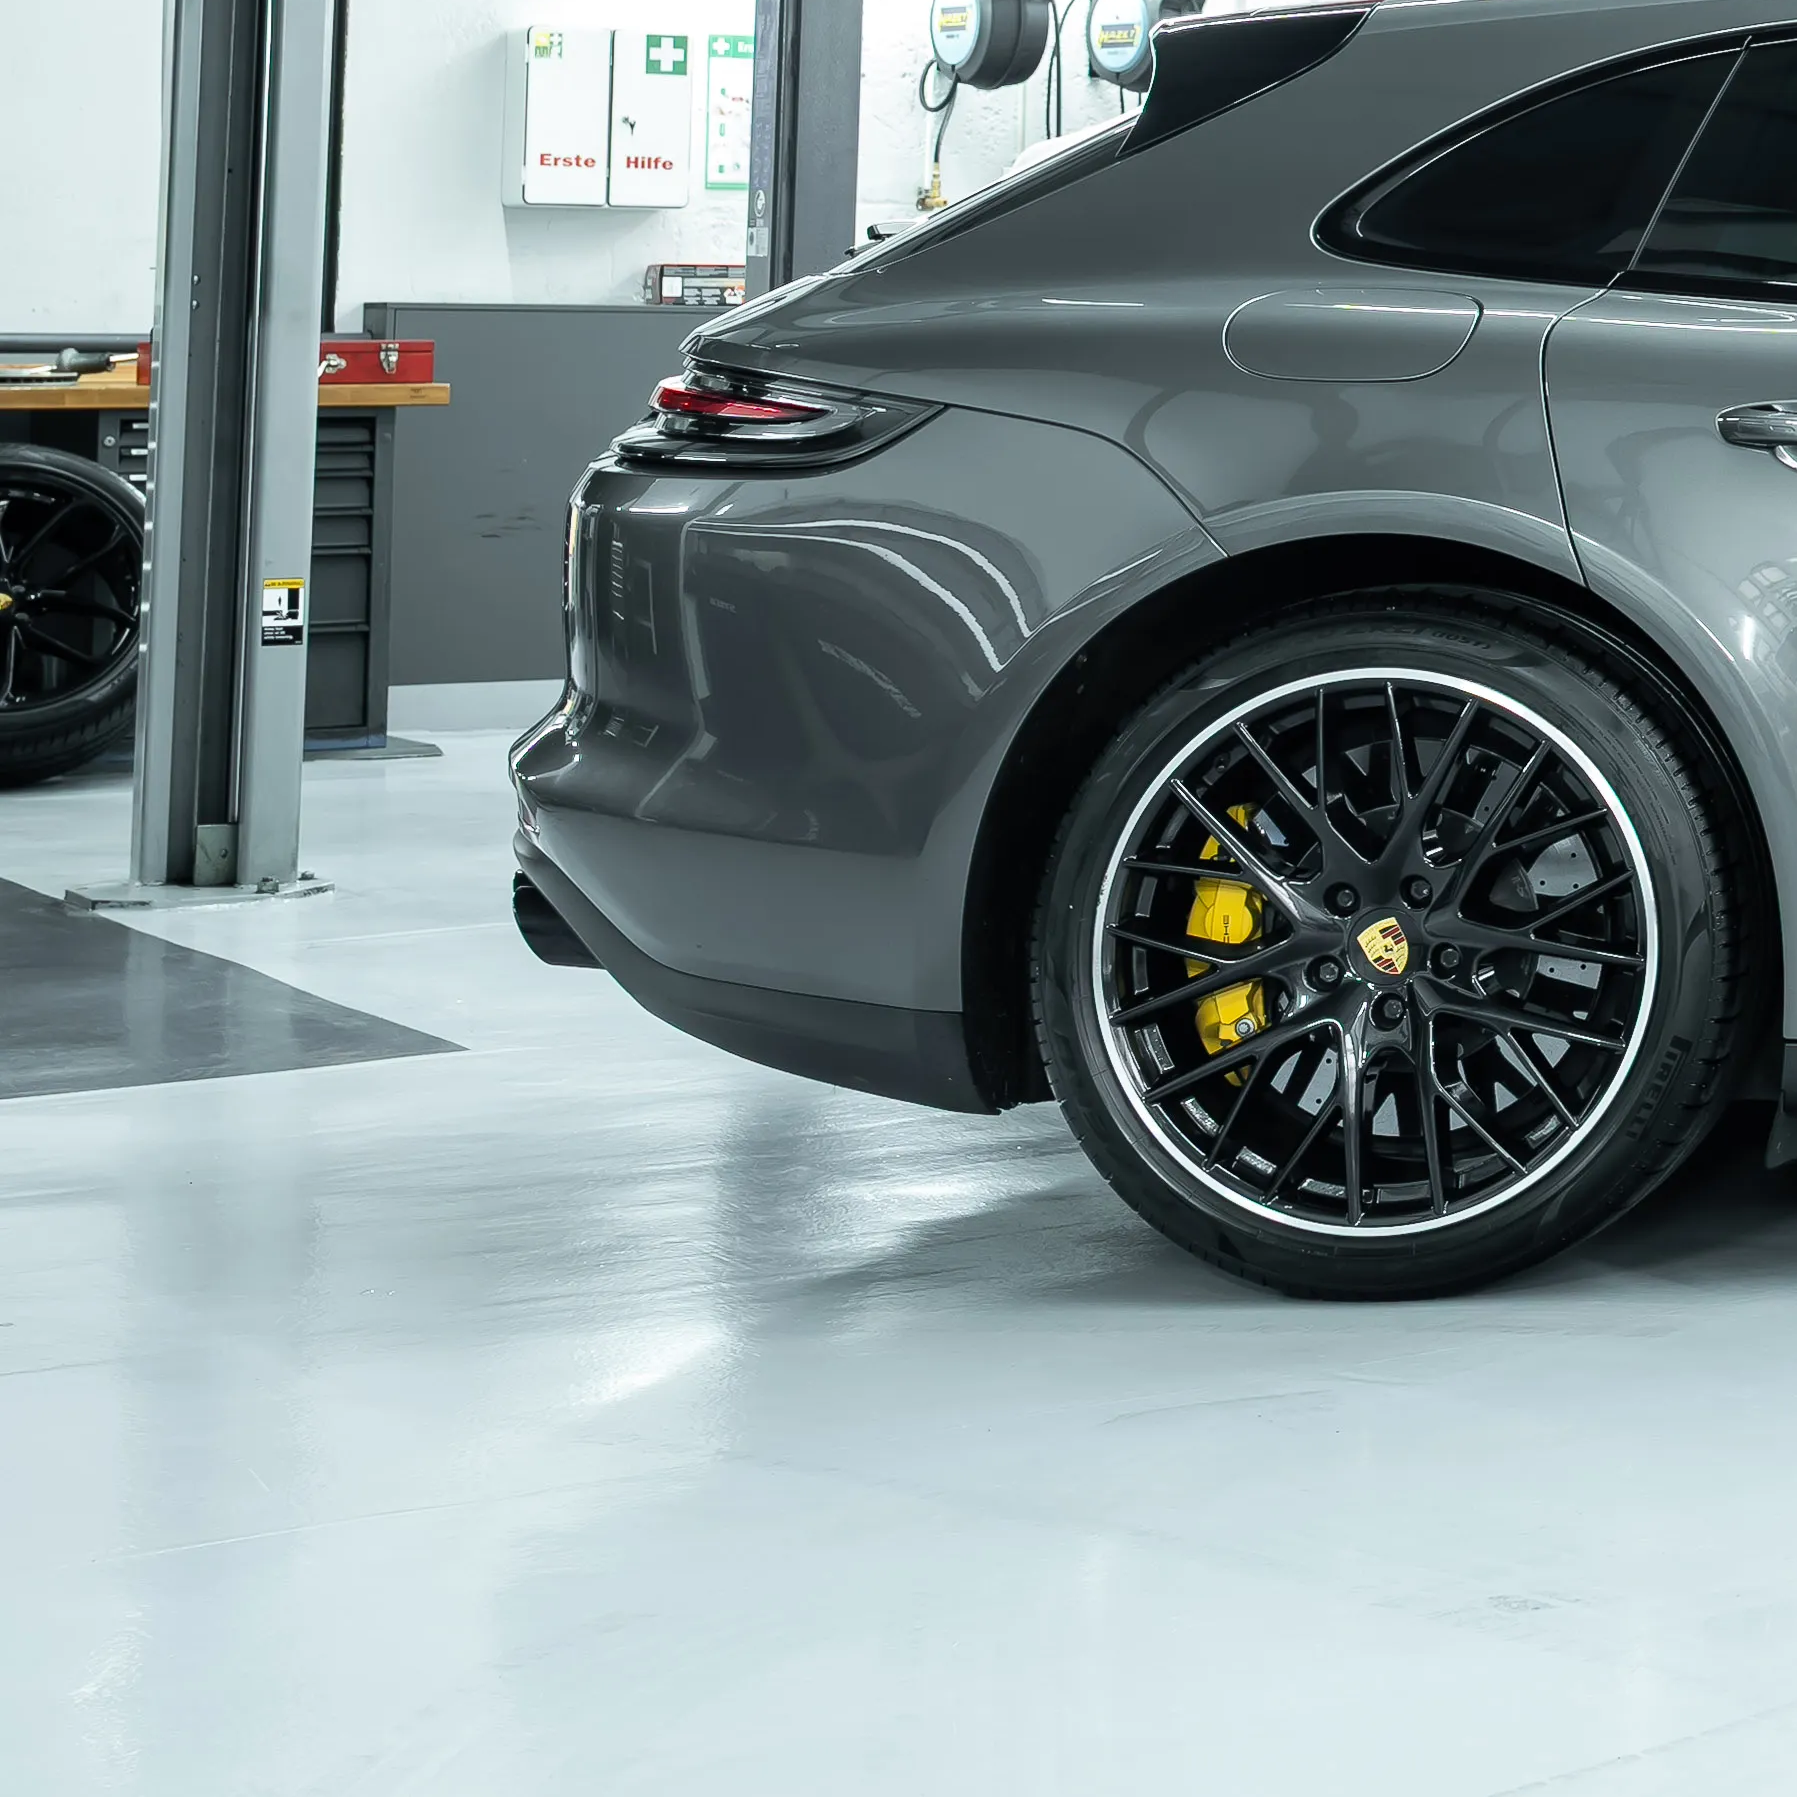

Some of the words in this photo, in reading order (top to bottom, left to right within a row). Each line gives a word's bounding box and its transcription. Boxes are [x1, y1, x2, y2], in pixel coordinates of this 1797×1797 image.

[539, 153, 596, 168] Erste
[626, 156, 674, 170] Hilfe
[1625, 1036, 1691, 1148] PIRELLI
